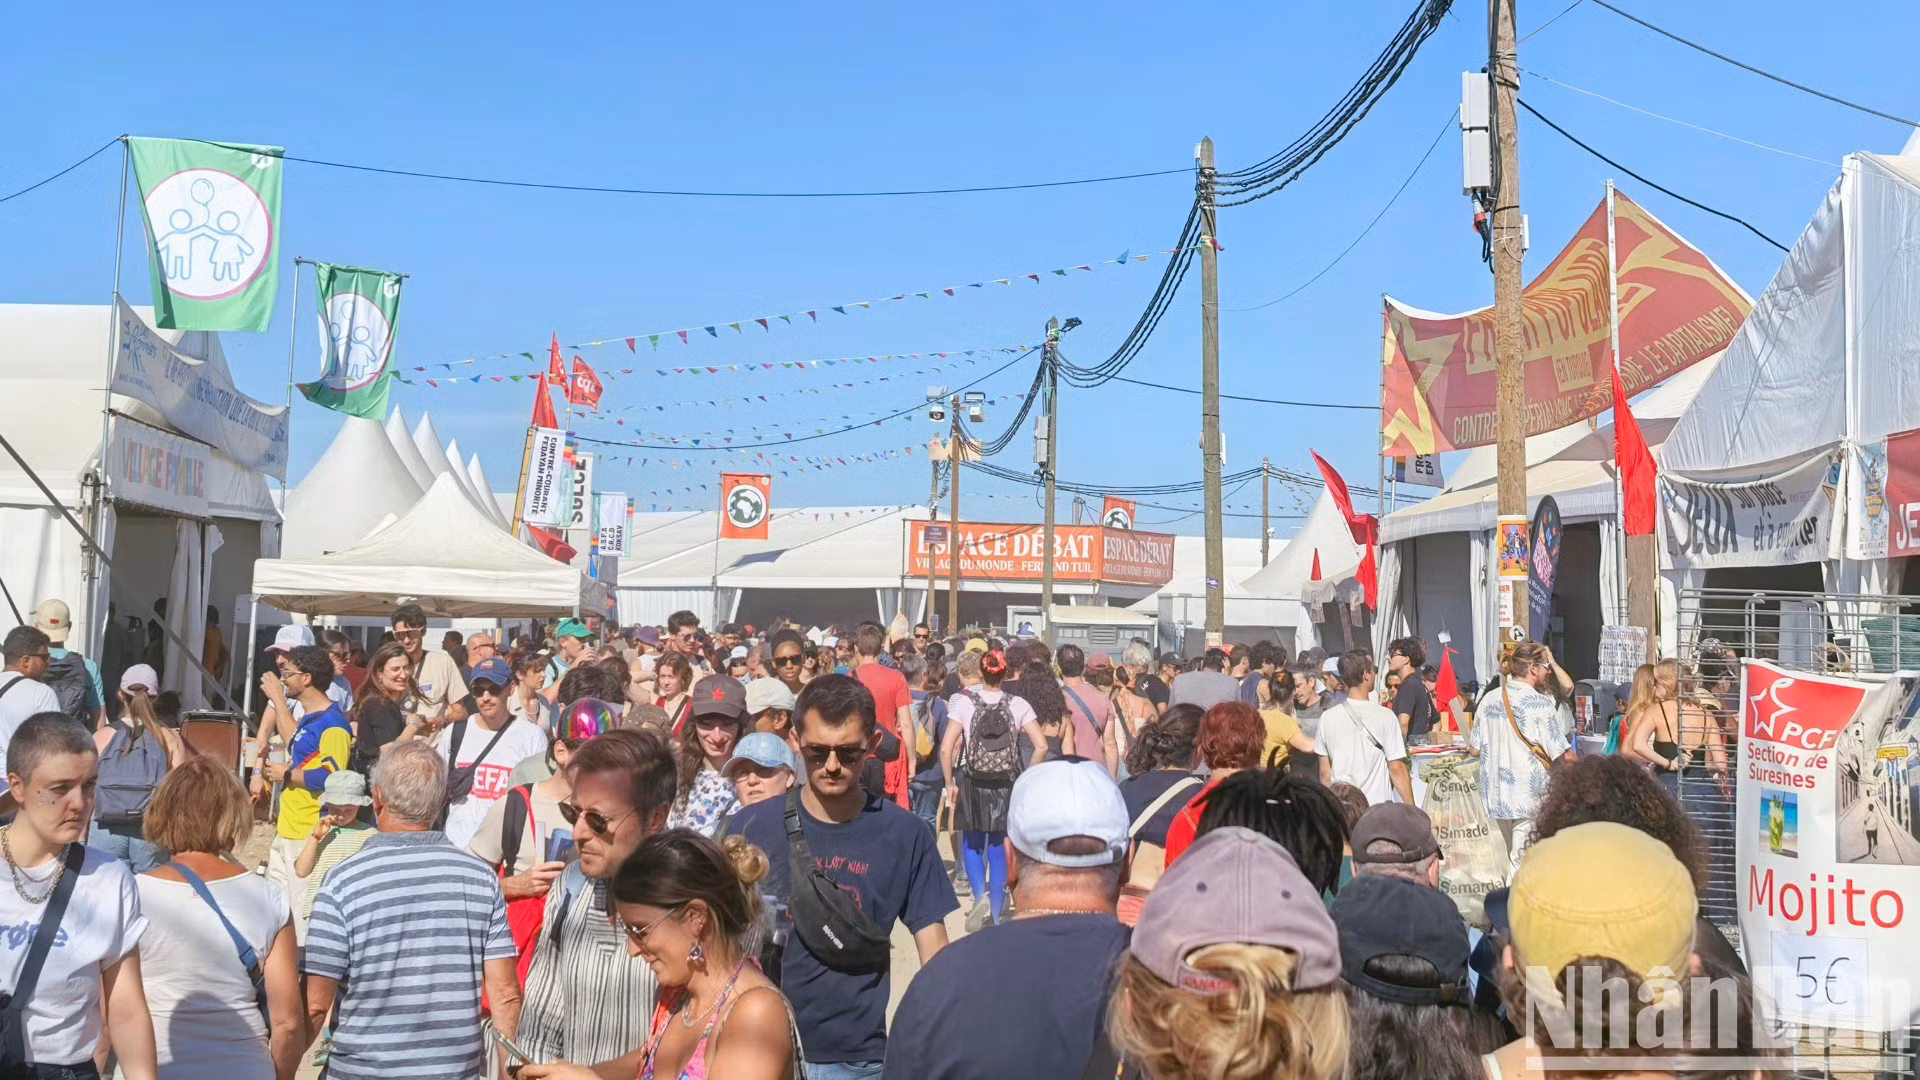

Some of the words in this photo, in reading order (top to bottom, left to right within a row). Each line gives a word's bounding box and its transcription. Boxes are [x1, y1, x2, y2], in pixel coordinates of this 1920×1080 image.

[537, 436, 549, 475] FEDAYAN
[540, 437, 557, 514] CONTRE-COURANT
[531, 475, 544, 515] MINORITÉ
[1731, 486, 1755, 509] sur
[1749, 474, 1787, 514] place
[1672, 482, 1738, 556] JEUX
[1754, 516, 1764, 551] et
[1767, 511, 1774, 550] à
[960, 558, 974, 570] DU
[976, 559, 1014, 572] MONDE
[1021, 560, 1070, 573] FERND
[1103, 535, 1139, 562] ESPACE
[1140, 536, 1171, 565] DÉBAT
[1748, 741, 1799, 768] Section
[1804, 752, 1828, 769] de
[1780, 721, 1838, 750] PCF
[1749, 762, 1816, 789] Suresnes
[1749, 864, 1904, 937] Mojito
[1795, 955, 1850, 1005] 5€
